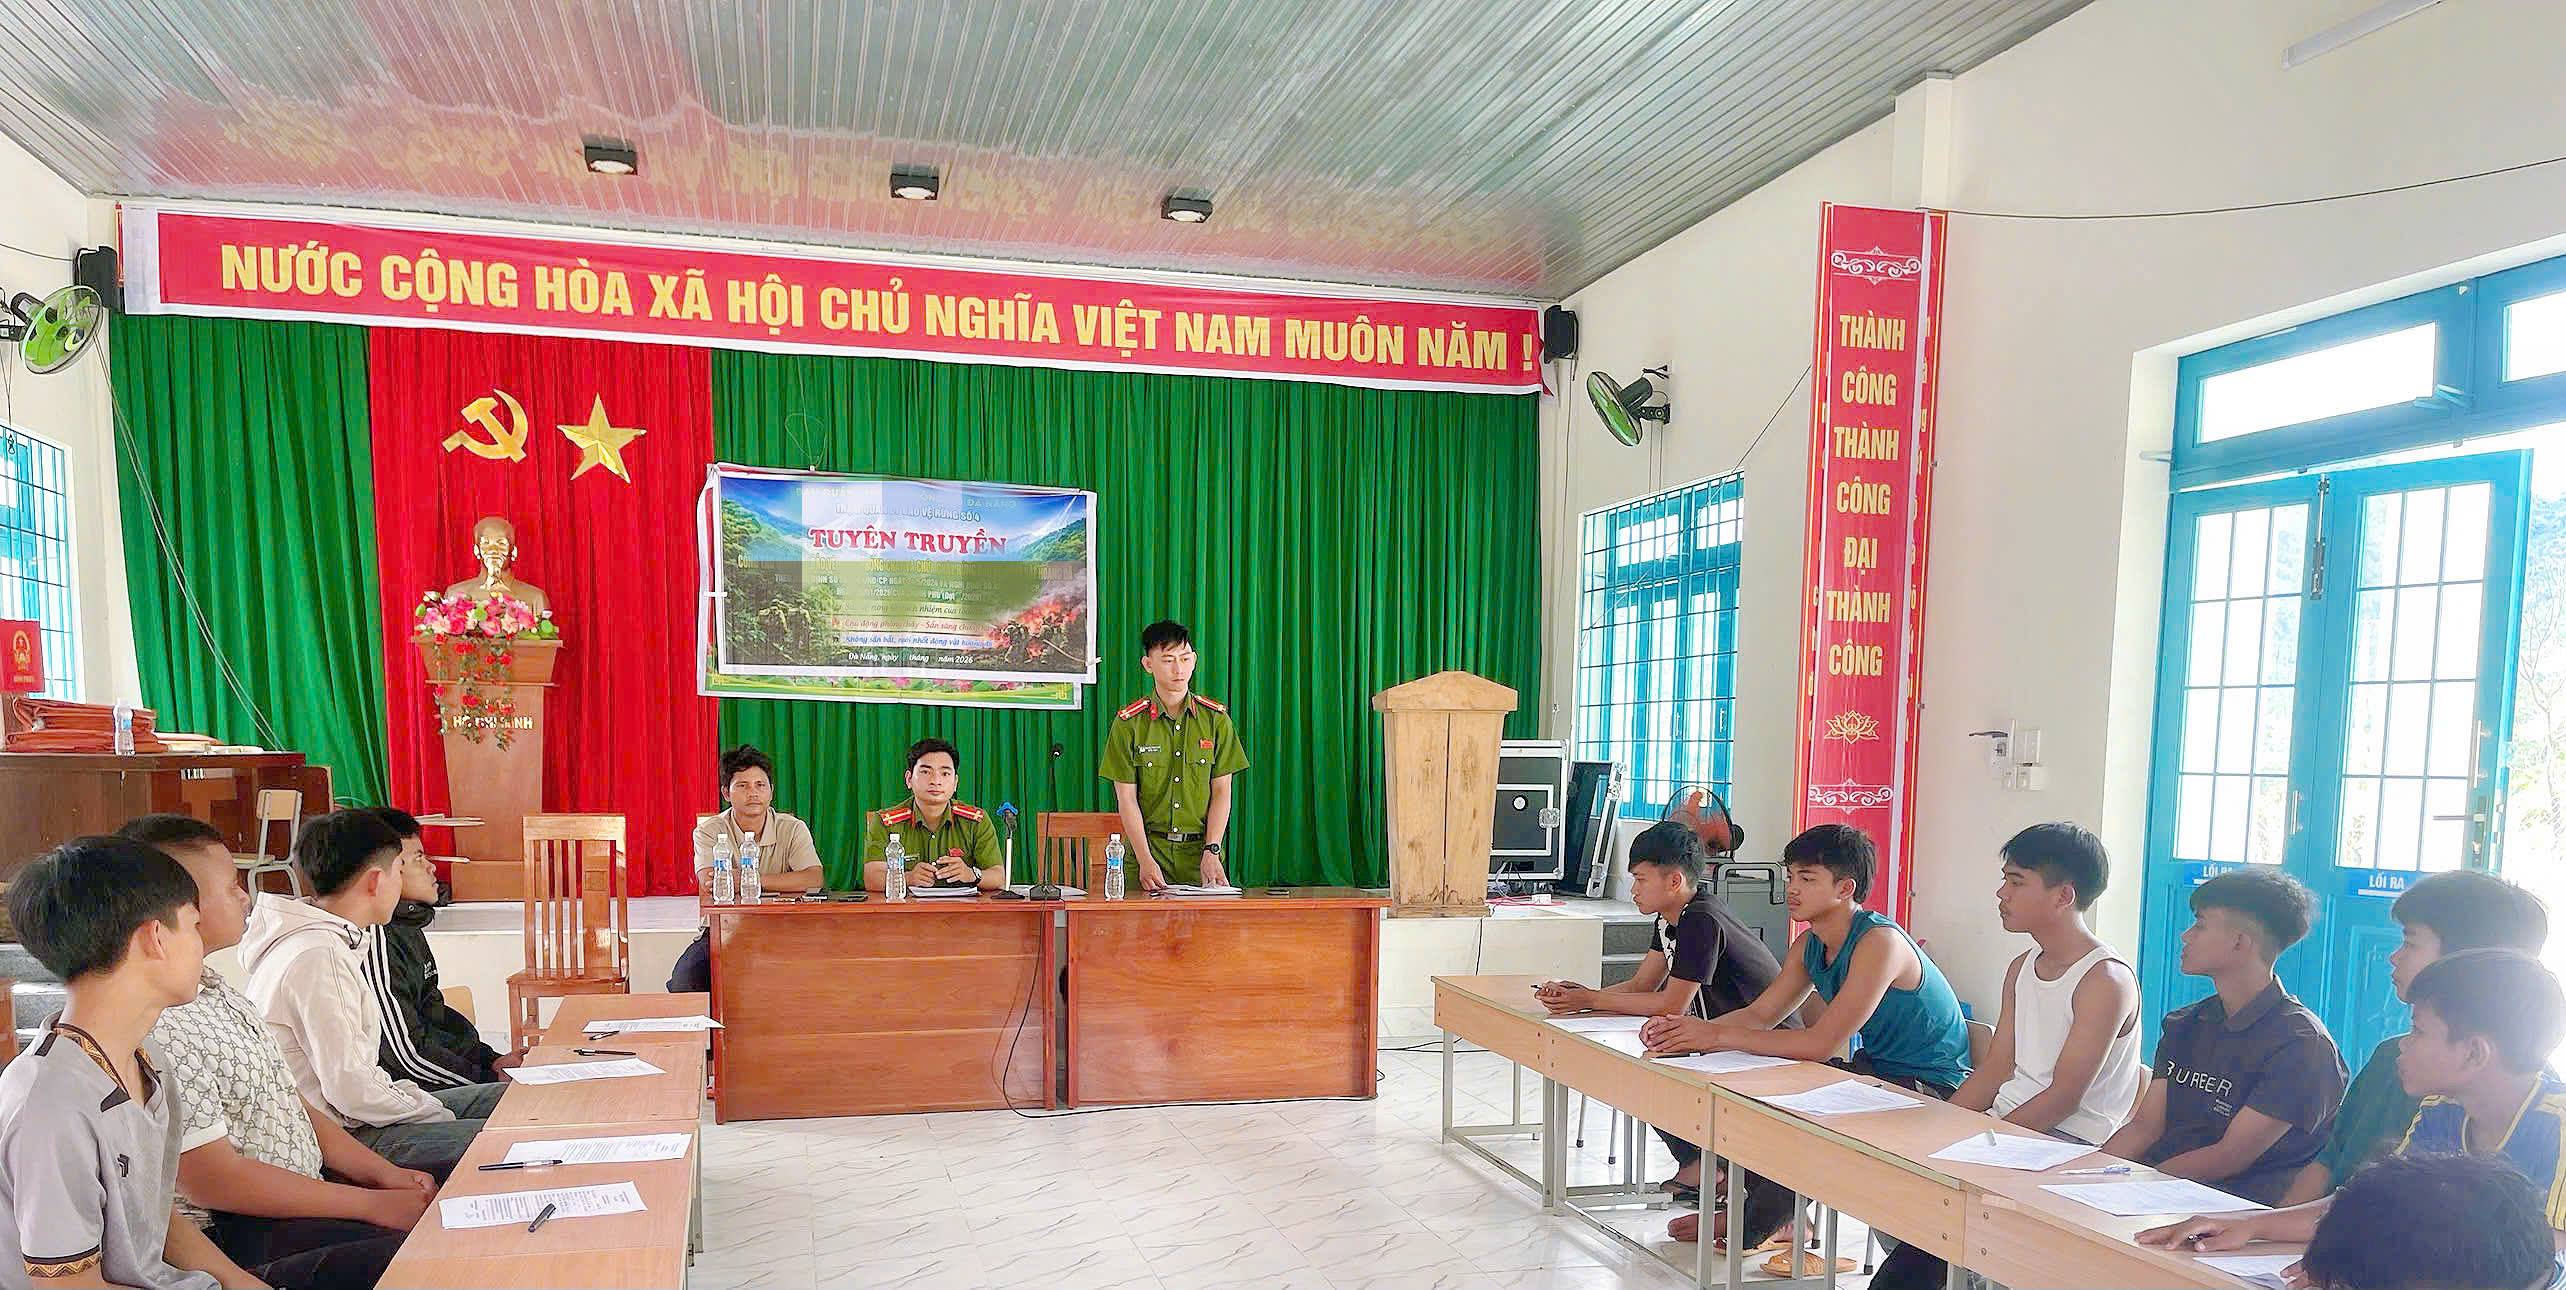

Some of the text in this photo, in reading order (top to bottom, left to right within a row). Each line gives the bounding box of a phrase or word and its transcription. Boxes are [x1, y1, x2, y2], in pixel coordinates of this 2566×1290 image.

[221, 241, 1533, 371] NƯỚC CỘNG HÒA XÃ HỘI CHỦ NGHĨA VIỆT NAM MUÔN NĂM !
[1840, 310, 1906, 351] THÀNH
[1841, 366, 1897, 406] CÔNG
[1834, 421, 1900, 461] THÀNH
[1836, 476, 1891, 515] CÔNG
[809, 525, 1007, 554] TUYÊN TRUYỀN
[1843, 537, 1878, 575] ĐẠI
[1826, 585, 1891, 623] THÀNH
[1828, 639, 1883, 677] CÔNG
[2369, 872, 2405, 890] LỐI RA
